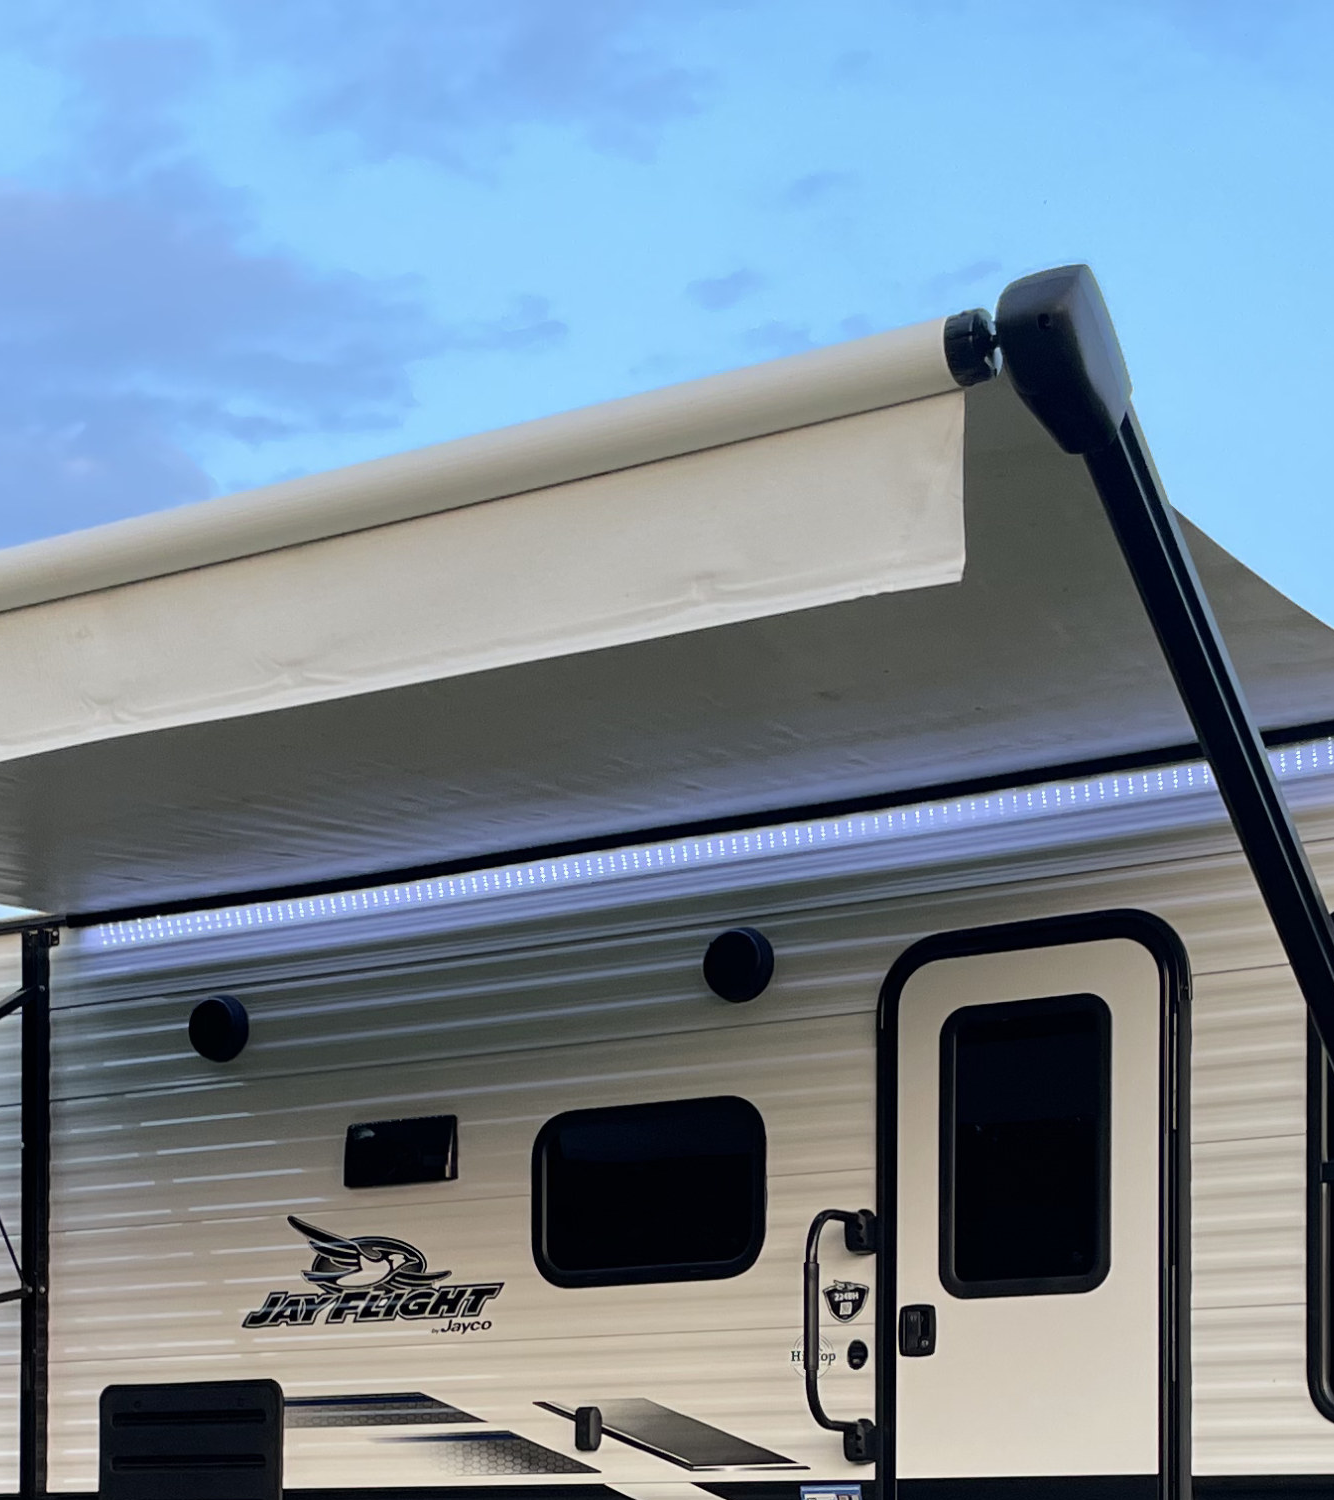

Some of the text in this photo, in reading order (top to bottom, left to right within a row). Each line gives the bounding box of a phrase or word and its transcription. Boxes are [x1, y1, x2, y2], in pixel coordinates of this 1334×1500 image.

[242, 1282, 505, 1328] JAY FLIGHT
[440, 1318, 492, 1335] Jayco
